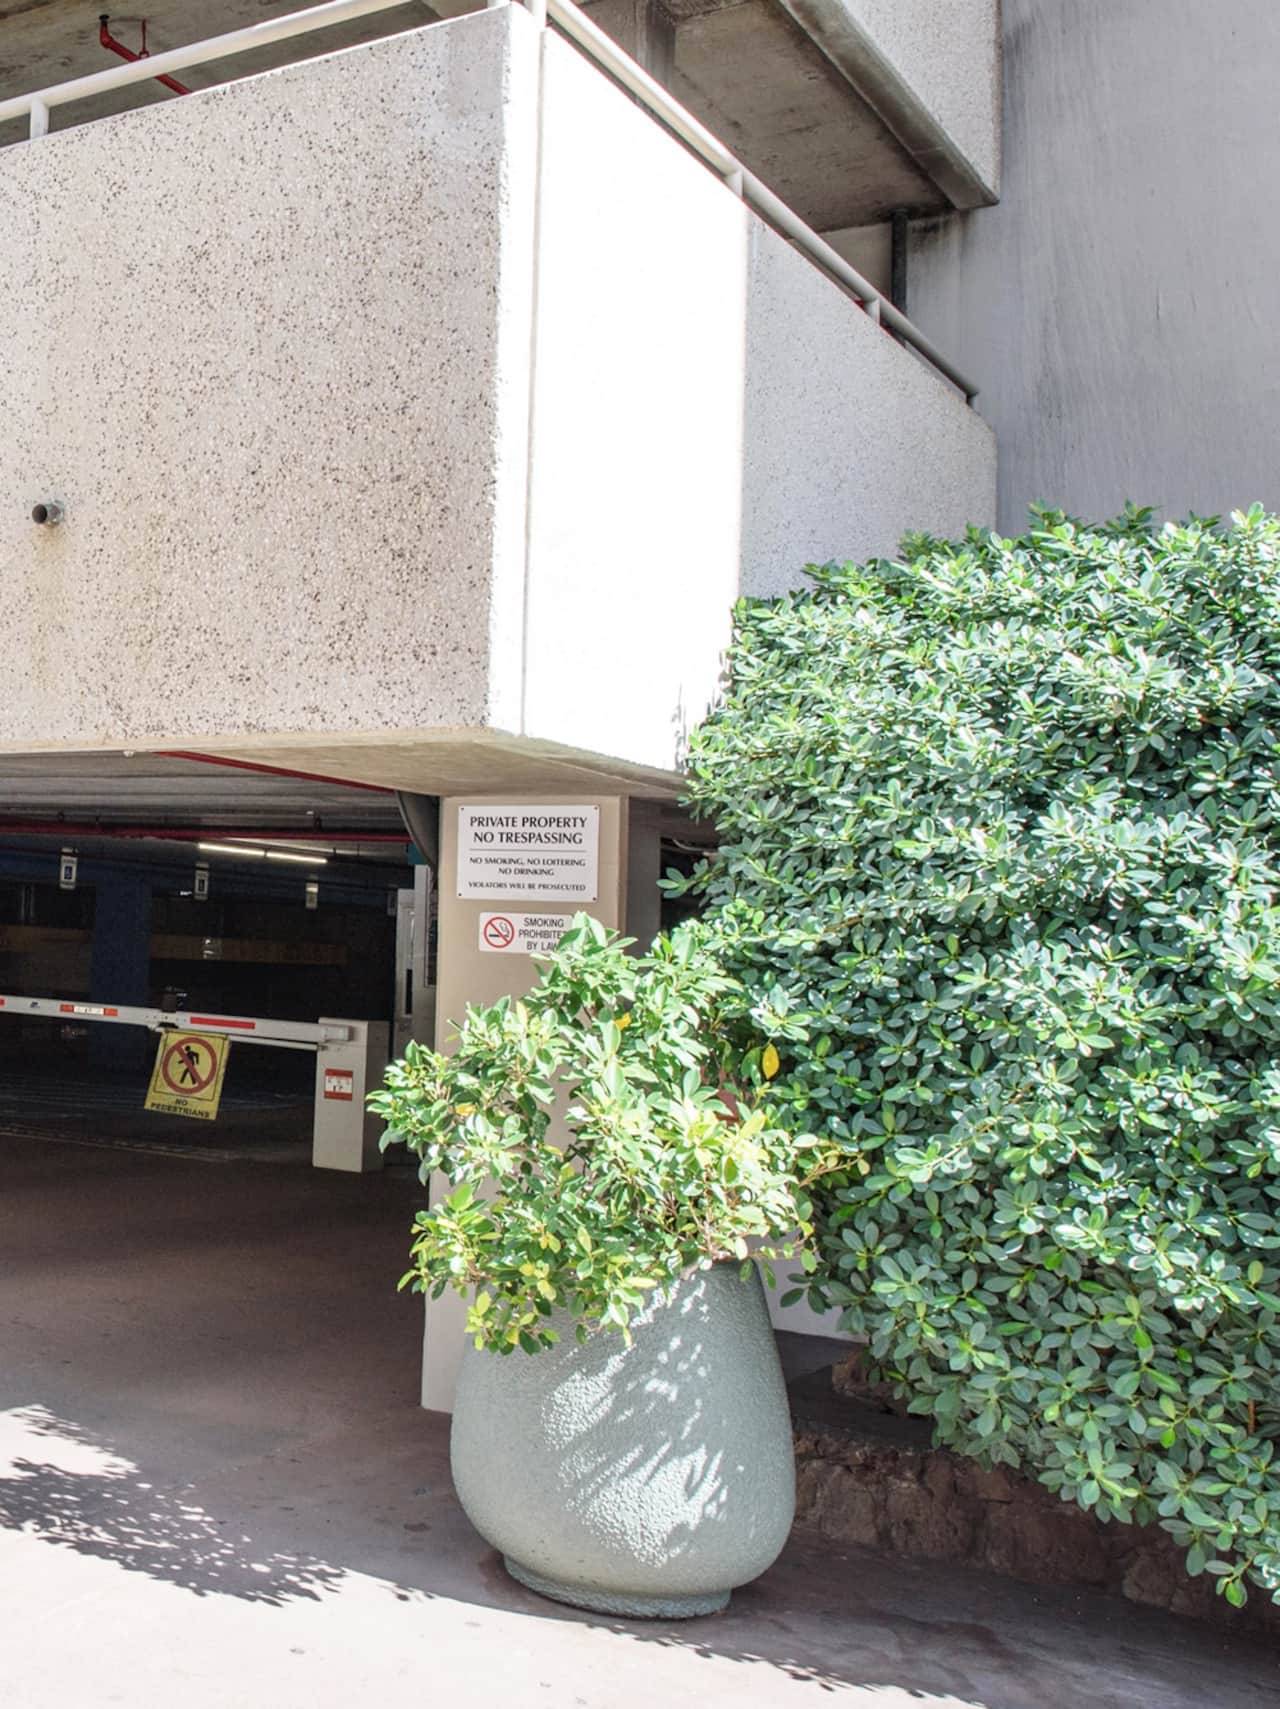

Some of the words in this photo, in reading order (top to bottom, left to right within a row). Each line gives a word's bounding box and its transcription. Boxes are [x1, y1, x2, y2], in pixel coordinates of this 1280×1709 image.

[470, 816, 518, 828] PRIVATE
[521, 816, 588, 828] PROPERTY
[473, 832, 495, 843] NO
[498, 832, 583, 844] TRESPASSING
[469, 857, 483, 865] NO
[527, 858, 540, 866] NO
[542, 858, 586, 867] LOITERING
[498, 867, 512, 875] NO
[513, 867, 554, 876] DRINKING
[468, 881, 508, 889] VIOLATORS
[509, 882, 526, 890] WILL
[523, 917, 565, 928] SMOKING
[518, 929, 567, 939] PROHIBITE
[526, 941, 538, 950] BY
[175, 1098, 188, 1106] NO
[151, 1103, 210, 1118] PEDESTRIANS
